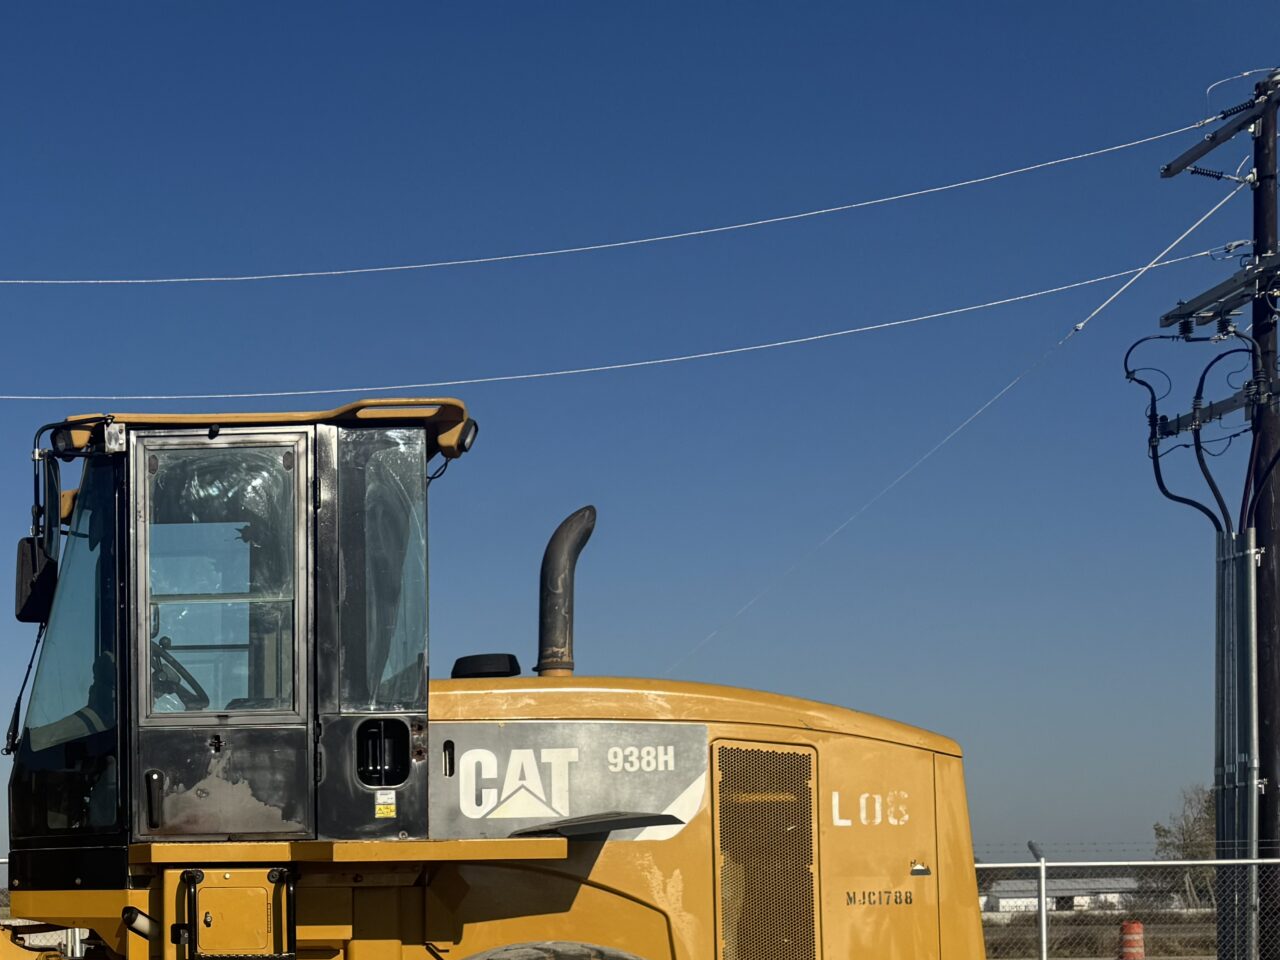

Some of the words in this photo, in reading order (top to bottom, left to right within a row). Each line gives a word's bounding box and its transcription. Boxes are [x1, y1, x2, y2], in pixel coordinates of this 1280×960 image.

[607, 746, 675, 772] 938H
[459, 748, 579, 819] CAT
[846, 891, 913, 906] MJC1788
